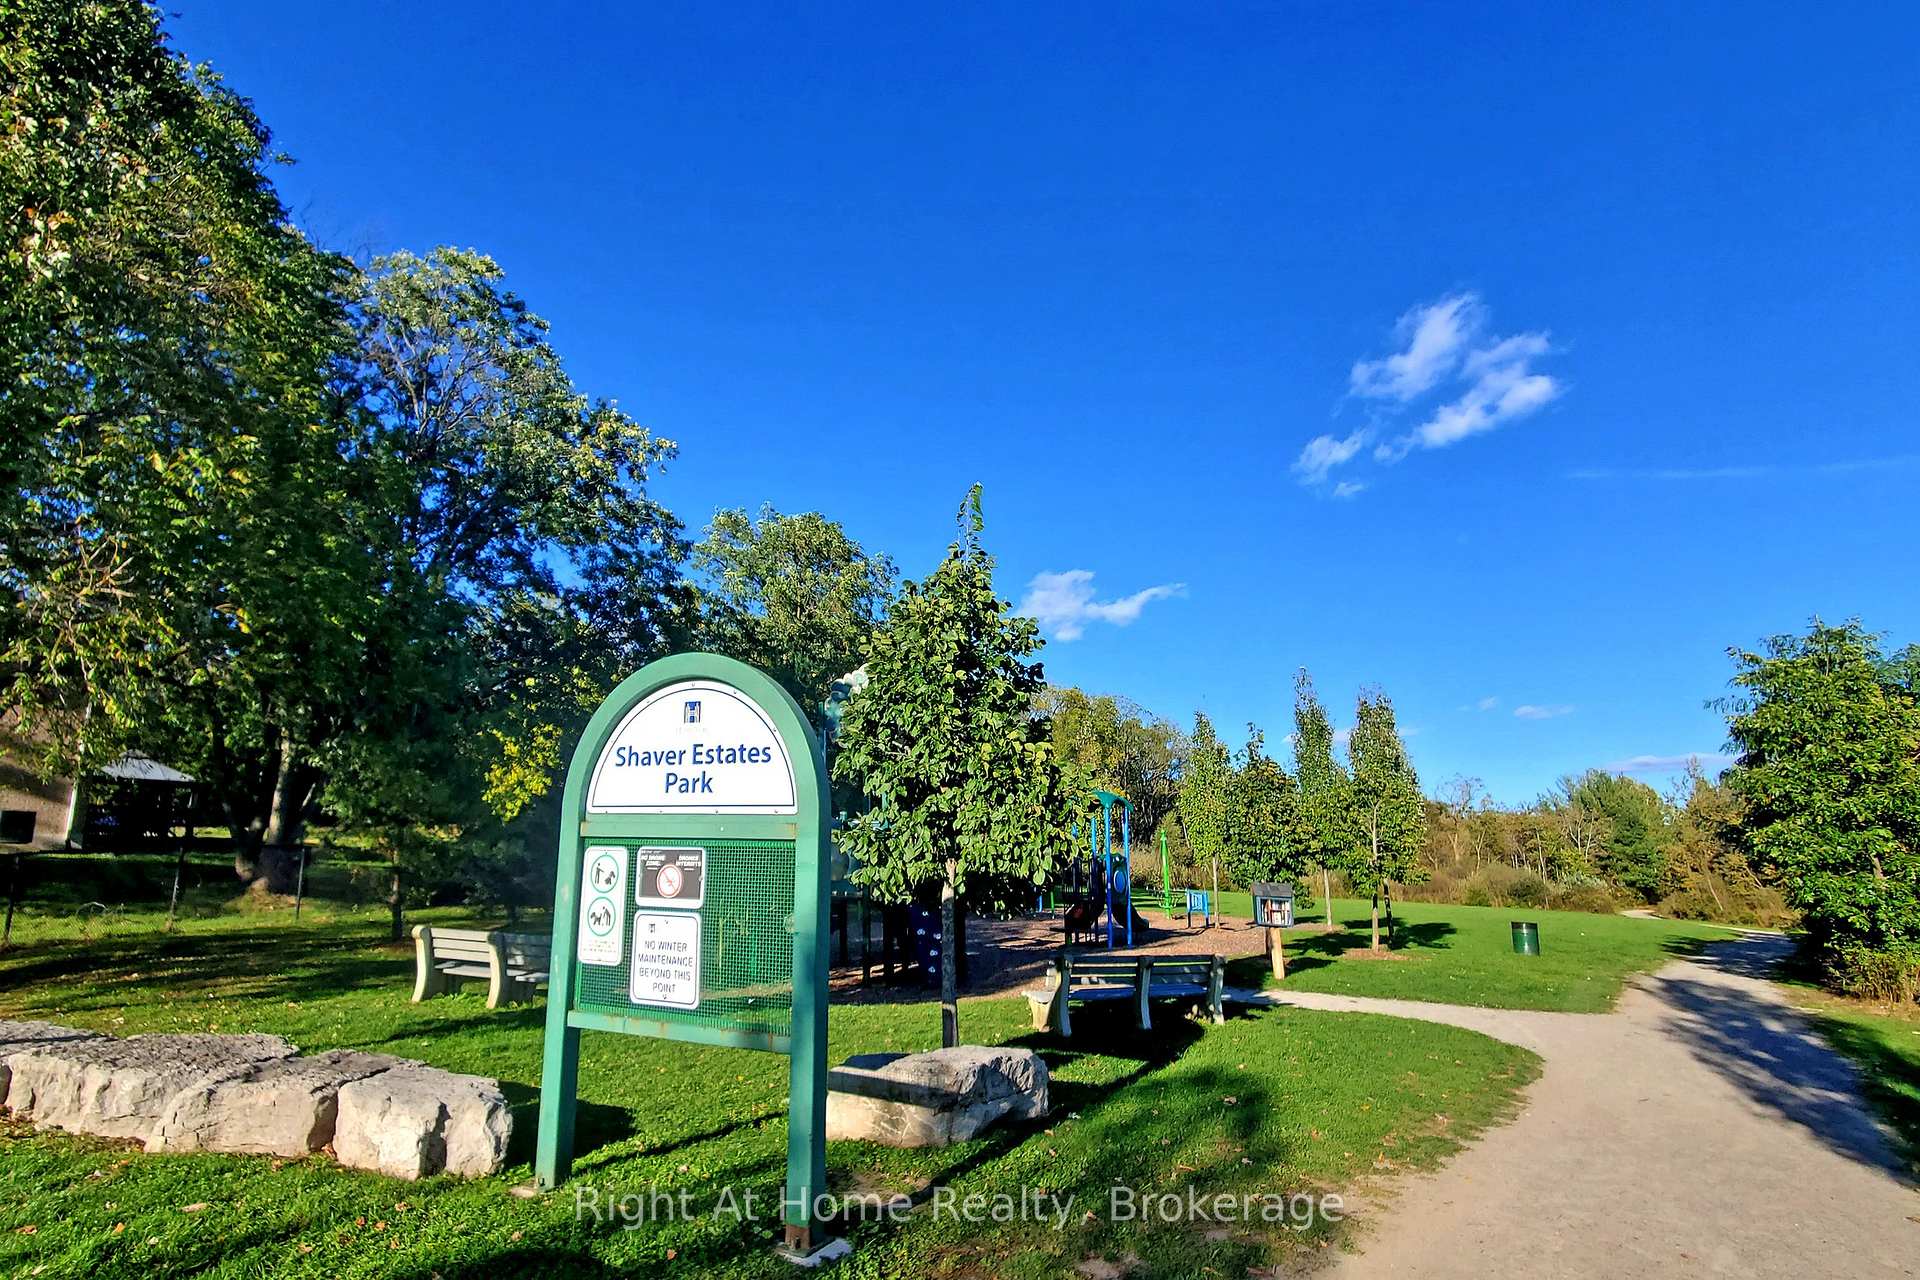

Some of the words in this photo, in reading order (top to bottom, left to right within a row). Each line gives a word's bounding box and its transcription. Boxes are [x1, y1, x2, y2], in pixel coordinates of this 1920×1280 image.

[615, 745, 686, 768] Shaver
[692, 743, 772, 765] Estates
[665, 771, 713, 793] Park
[644, 940, 656, 950] NO
[658, 941, 688, 952] WINTER
[638, 953, 693, 967] MAINTENANCE
[639, 967, 671, 979] BEYOND
[674, 969, 691, 981] THIS
[652, 982, 676, 993] POINT
